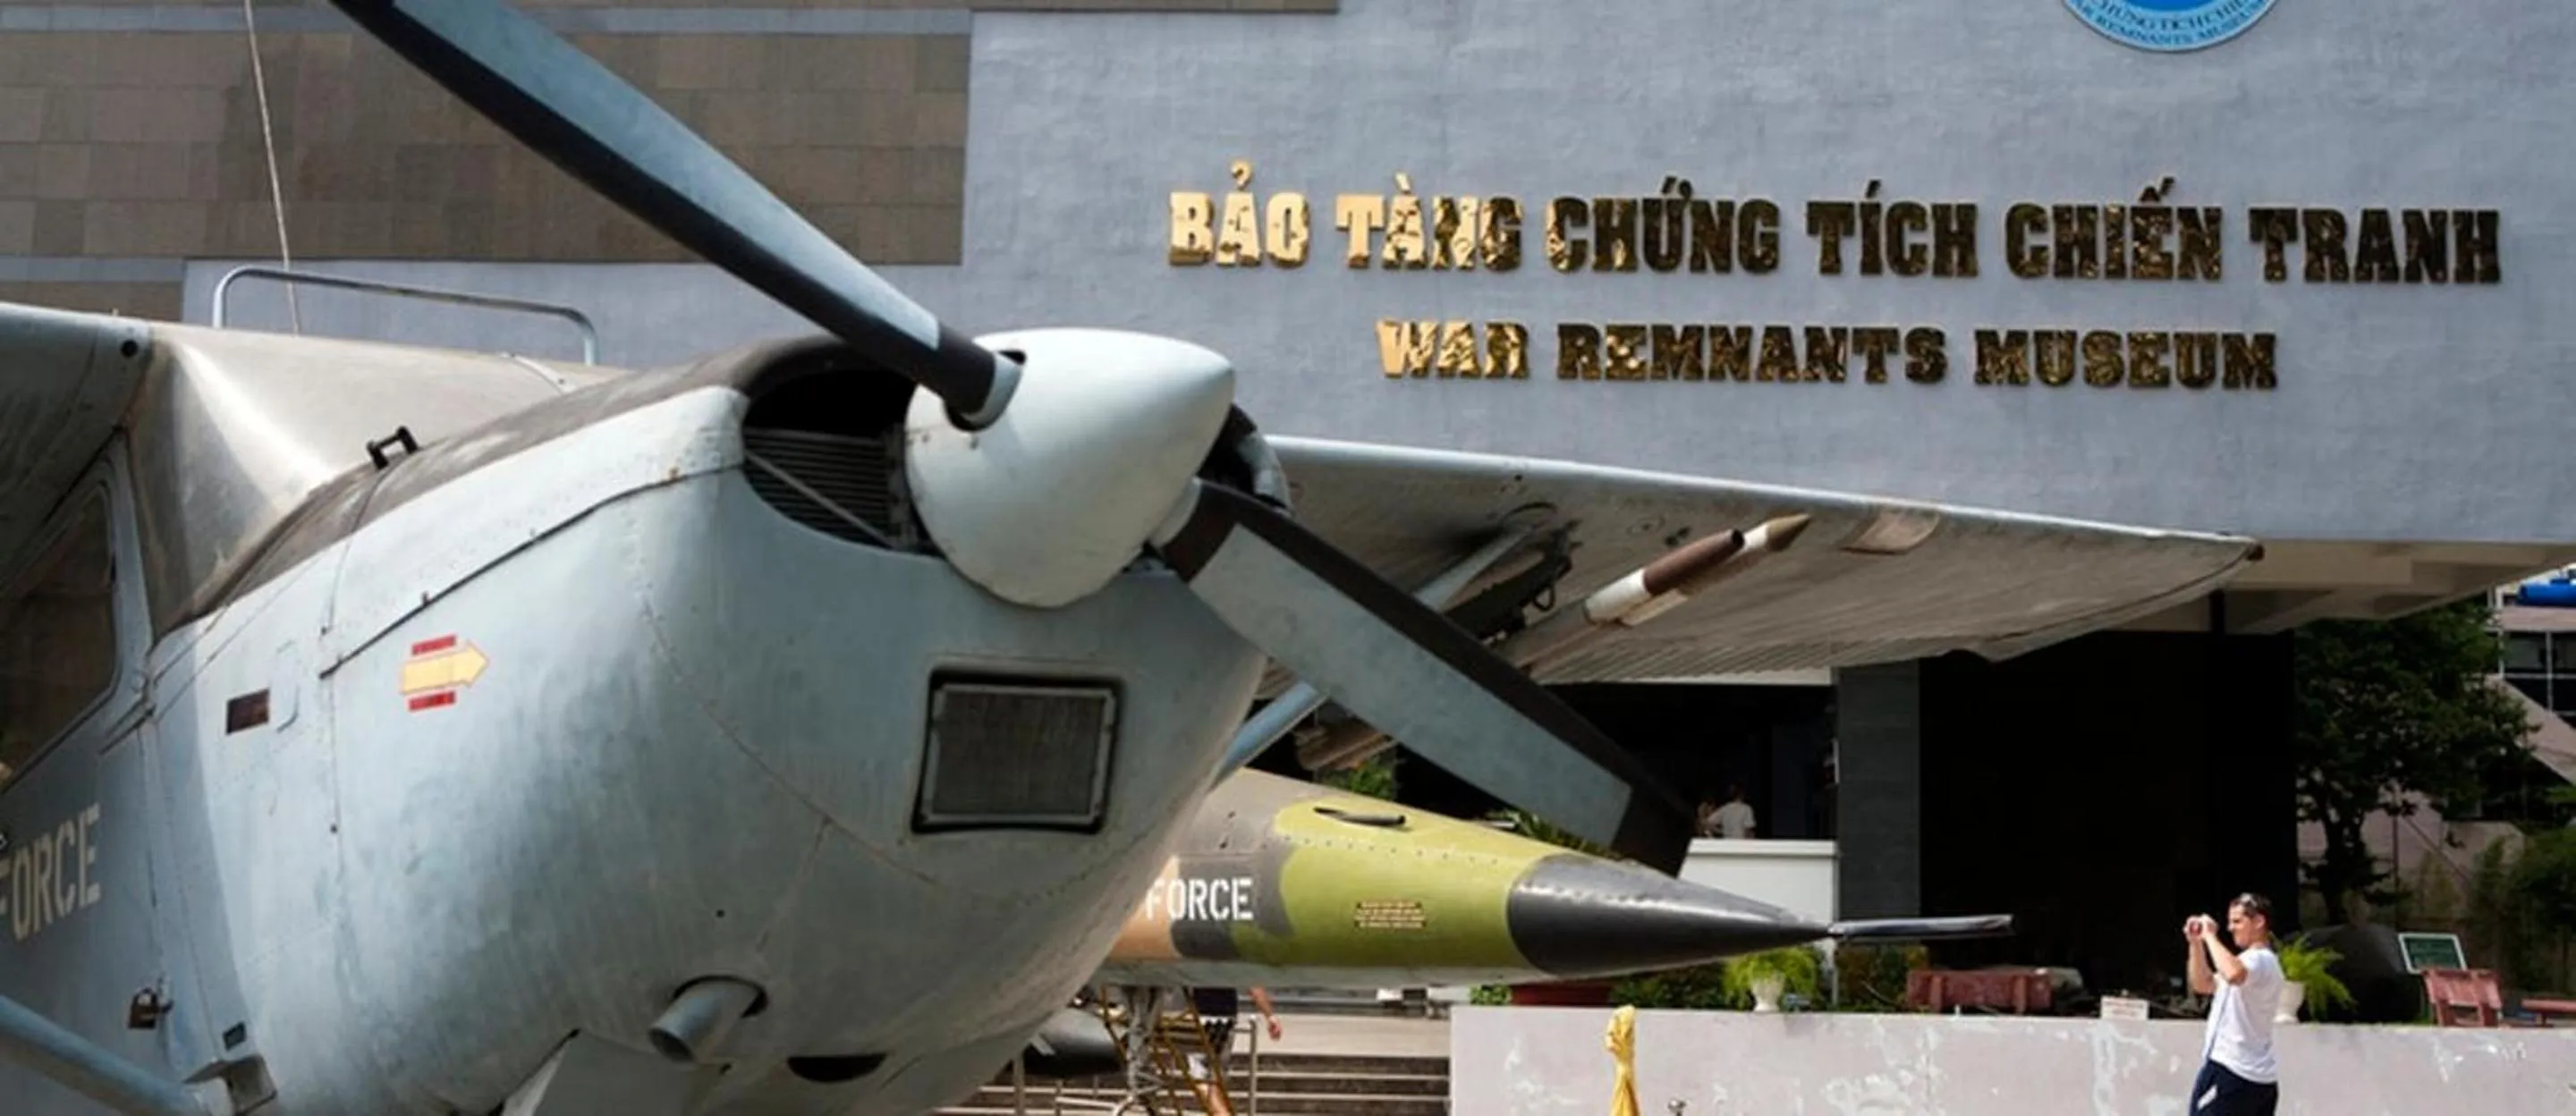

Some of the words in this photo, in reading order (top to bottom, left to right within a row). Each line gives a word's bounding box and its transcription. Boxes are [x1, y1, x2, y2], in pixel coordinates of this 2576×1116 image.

[1169, 159, 1310, 267] BẢO
[1335, 171, 1524, 272] TÀNG
[1546, 176, 1782, 275] CHỨNG
[1805, 180, 1979, 279] TÍCH
[2006, 176, 2224, 283] CHIẾN
[2248, 207, 2503, 284] TRANH
[1377, 317, 1531, 380] WAR
[1556, 324, 1949, 384] REMNANTS
[1973, 328, 2277, 390] MUSEUM
[1145, 876, 1254, 922] FORCE
